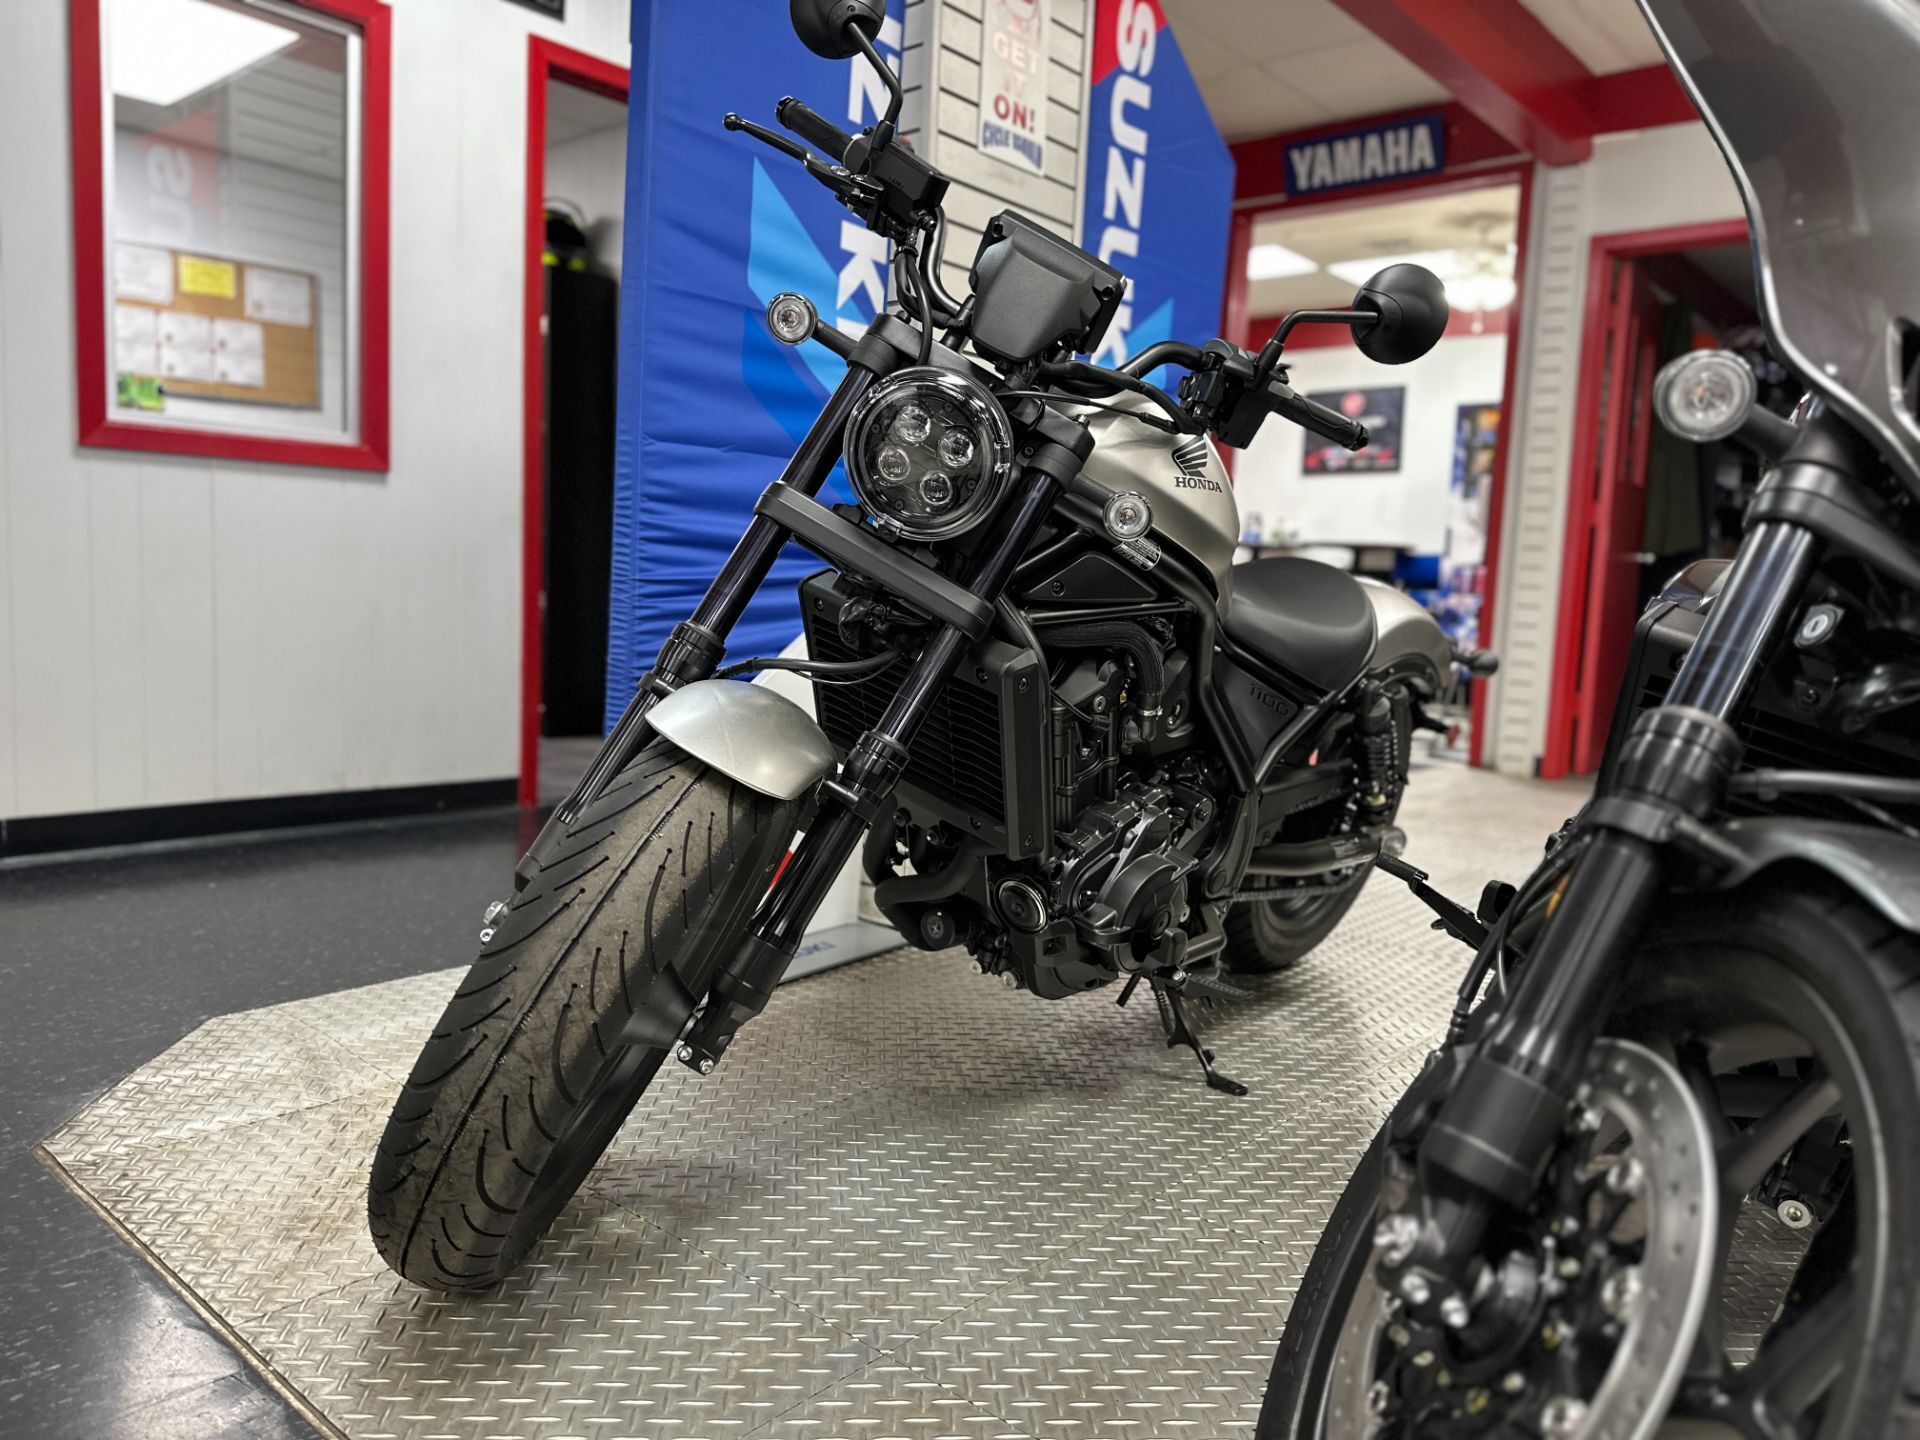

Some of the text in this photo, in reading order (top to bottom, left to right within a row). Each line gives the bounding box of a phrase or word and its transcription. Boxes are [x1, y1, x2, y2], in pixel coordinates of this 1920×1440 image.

[993, 31, 1040, 74] GET
[1004, 69, 1026, 97] IT
[993, 93, 1036, 133] ON!
[1289, 123, 1436, 191] YAMAHA
[1090, 0, 1157, 370] SUZUK
[1174, 476, 1222, 493] HONDA
[1249, 683, 1289, 716] 1100
